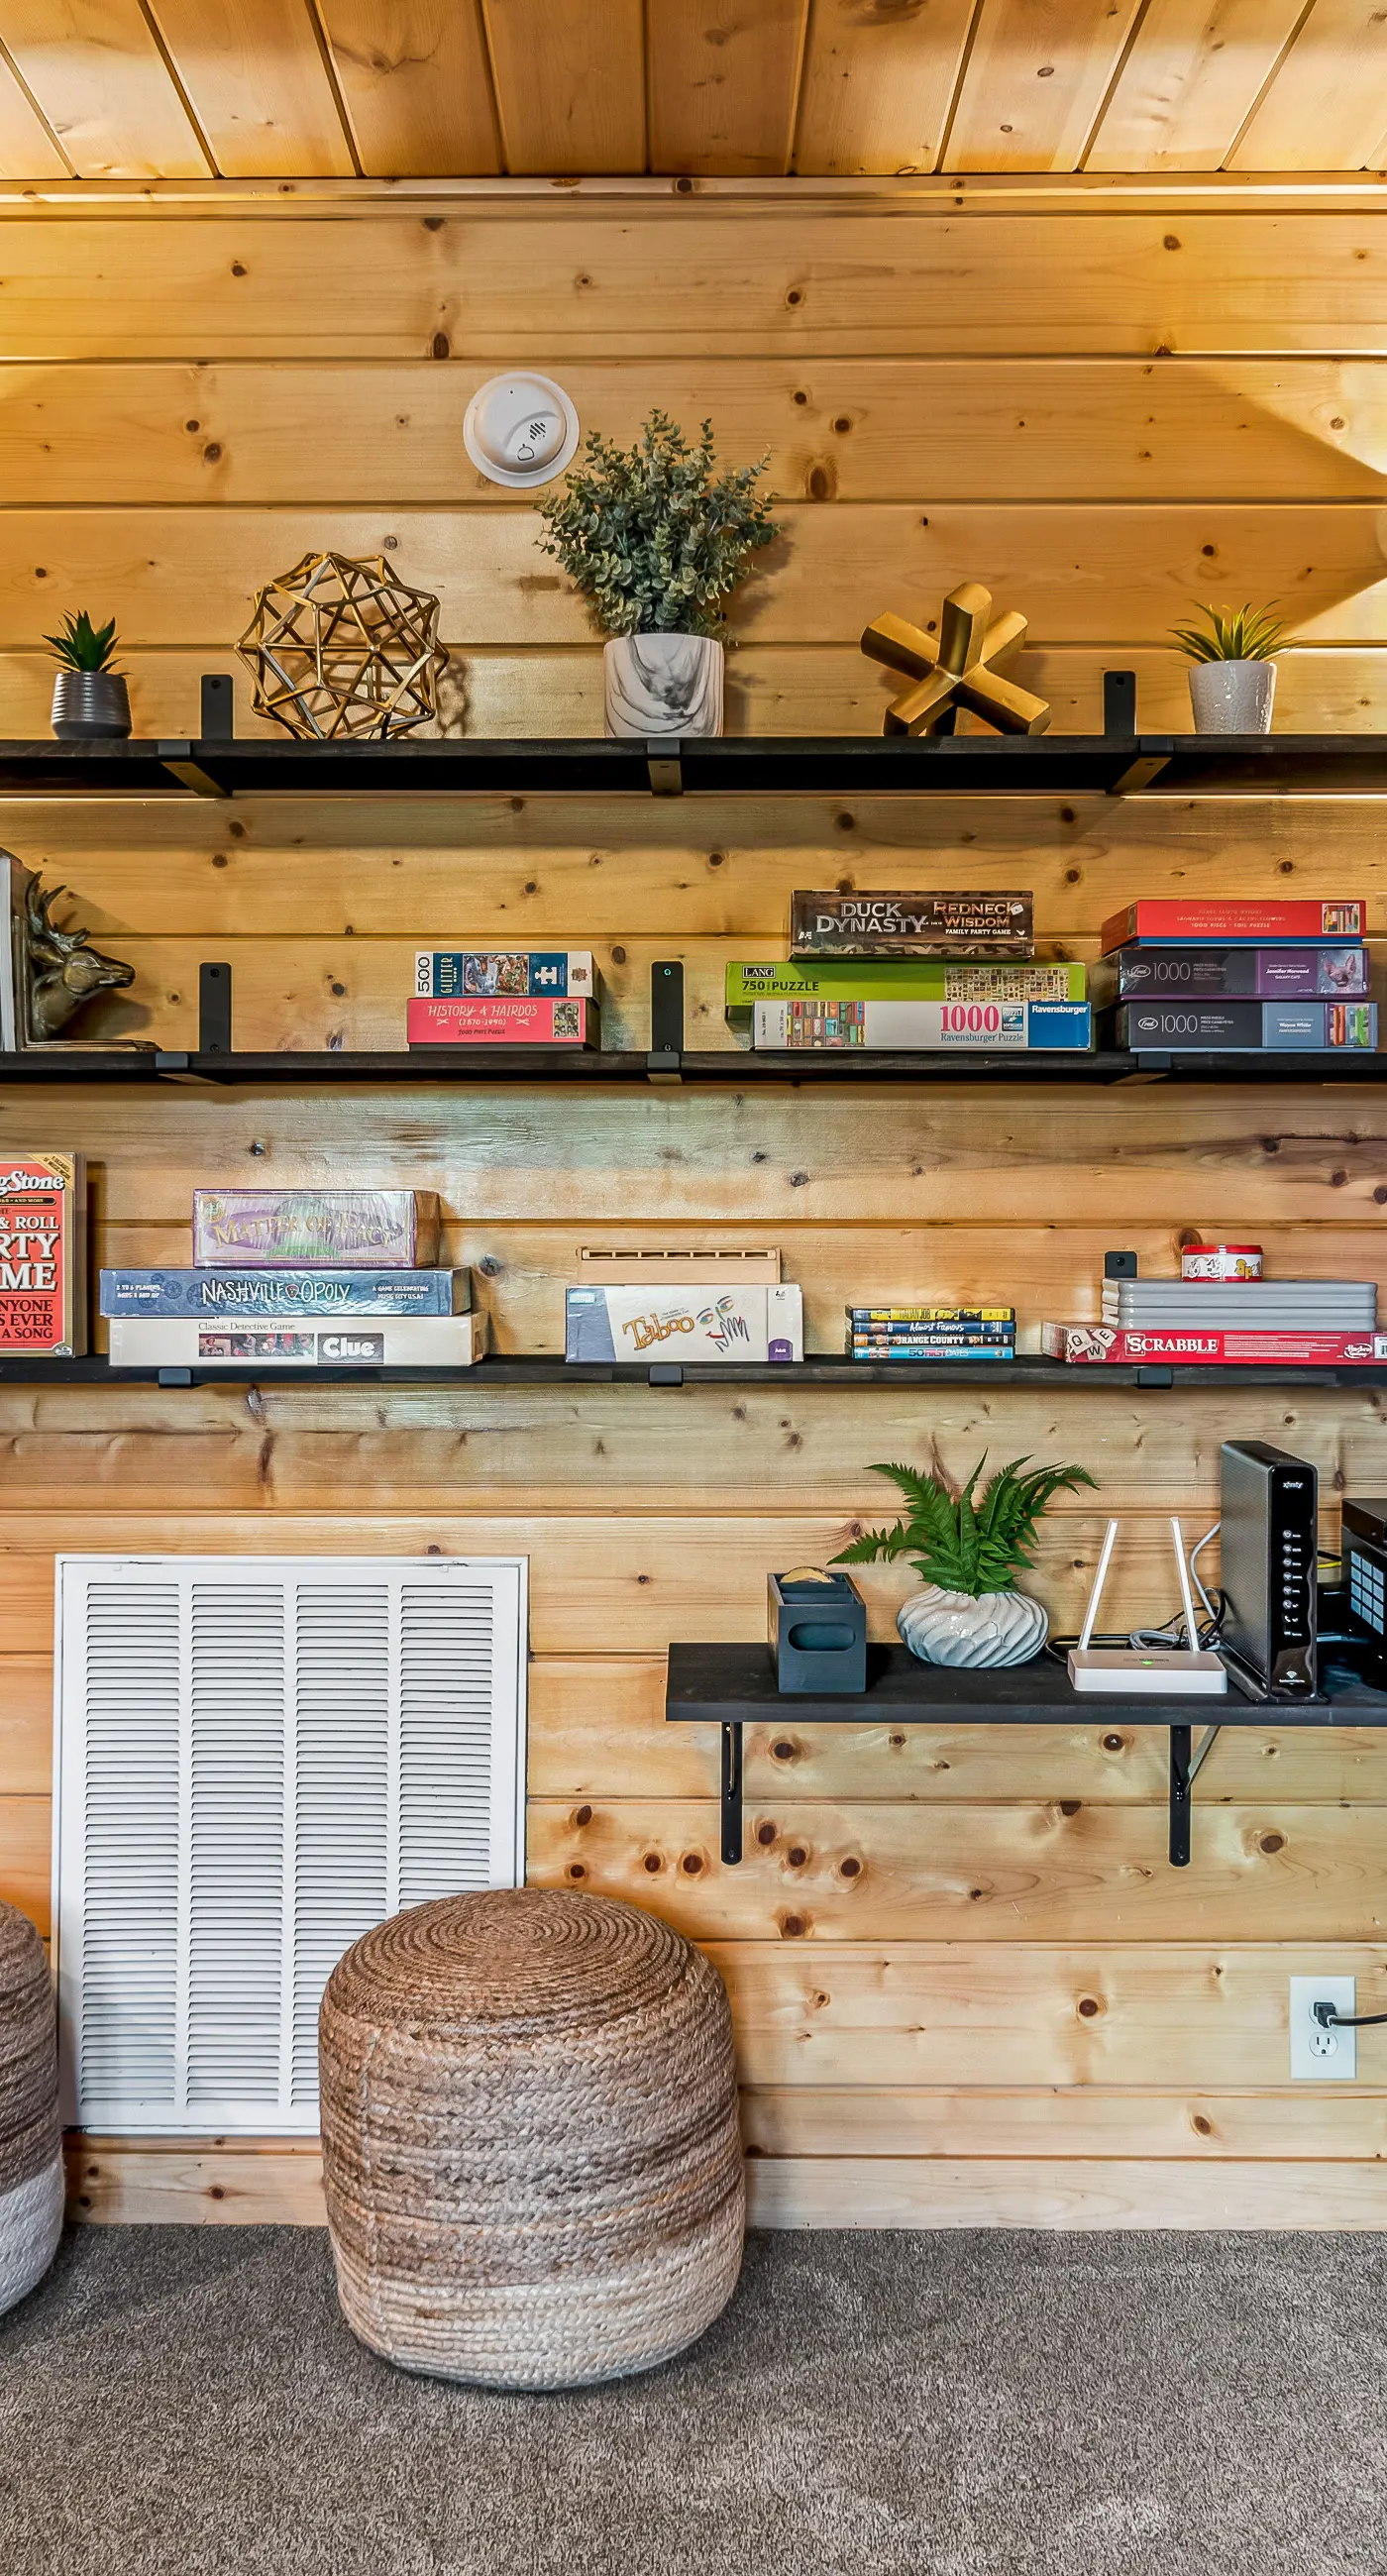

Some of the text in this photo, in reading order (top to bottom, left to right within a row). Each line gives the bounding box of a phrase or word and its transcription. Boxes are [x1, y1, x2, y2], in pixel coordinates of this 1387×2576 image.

[840, 903, 903, 917] DUCK
[933, 901, 1014, 915] REDNECK
[815, 914, 928, 933] DYNASTY
[944, 915, 1011, 927] WISDOM
[418, 956, 431, 993] 500
[440, 957, 453, 994] GLITTER
[745, 967, 774, 977] LANG
[1153, 962, 1191, 981] 1000
[742, 981, 765, 991] 750
[772, 981, 819, 991] PUZZLE
[428, 1005, 538, 1018] HISTORY & HAIRDOS
[1031, 1005, 1088, 1016] Ravensburger
[940, 1005, 1000, 1032] 1000
[1160, 1015, 1198, 1033] 1000
[941, 1033, 1023, 1043] Ravensburger Puzzle
[15, 1216, 59, 1231] ROLL
[213, 1215, 300, 1249] MATTER
[306, 1216, 333, 1234] OF
[0, 1262, 56, 1292] ME
[10, 1313, 53, 1327] EVER
[920, 1309, 931, 1320] JOB
[1, 1328, 53, 1339] A SONG
[622, 1313, 695, 1350] Taboo
[909, 1322, 965, 1333] Almost Famous
[929, 1335, 964, 1344] COUNTY
[1071, 1335, 1084, 1347] Q
[1099, 1330, 1110, 1341] E
[323, 1337, 375, 1360] Clue
[1089, 1344, 1102, 1356] W
[1128, 1337, 1218, 1353] SCRABBLE
[946, 1348, 969, 1357] DATES
